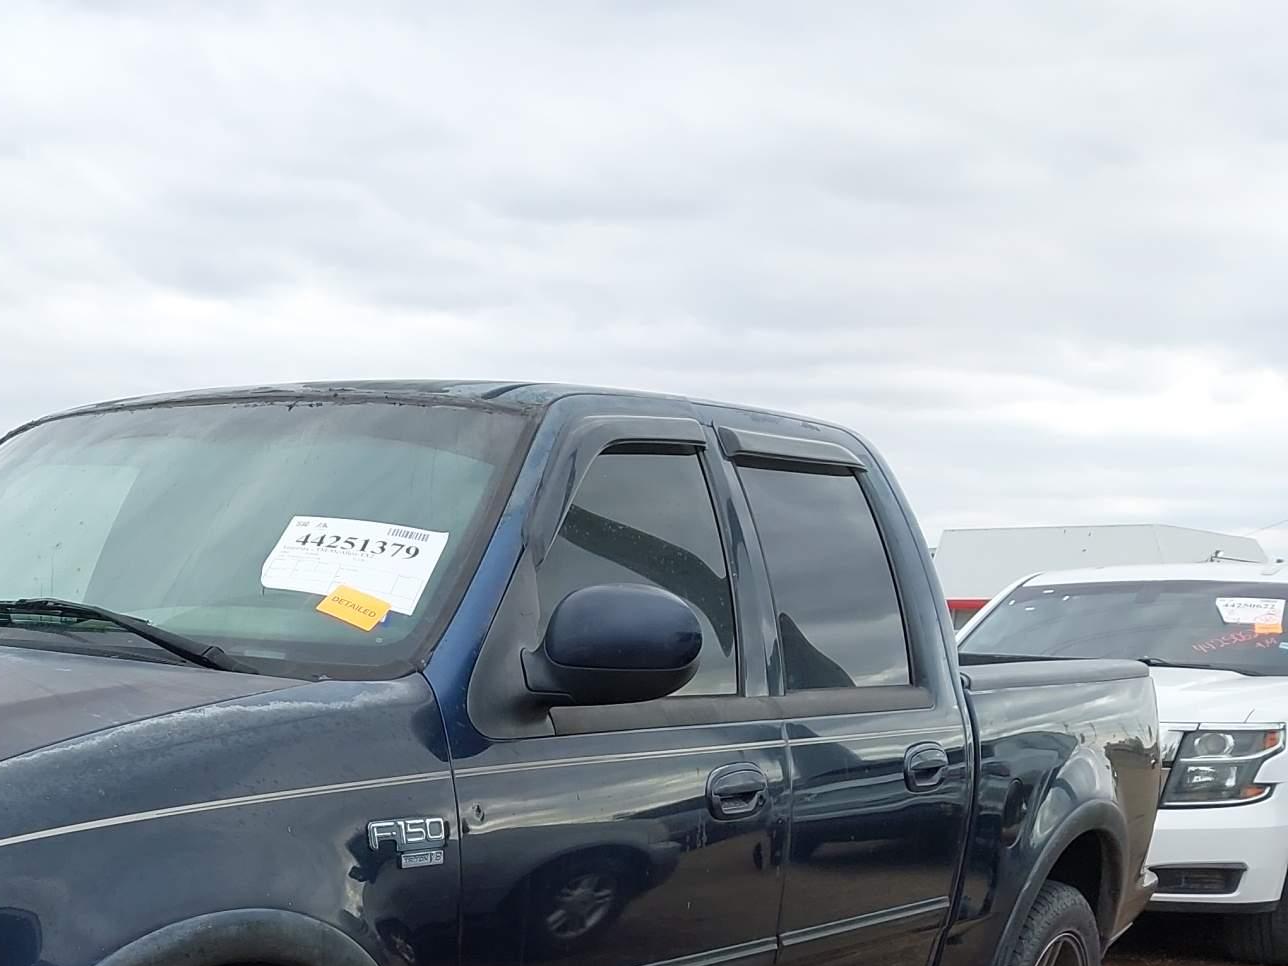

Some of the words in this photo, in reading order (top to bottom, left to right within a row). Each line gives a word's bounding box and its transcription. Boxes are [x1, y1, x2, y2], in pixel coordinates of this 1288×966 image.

[295, 532, 420, 560] 44251379
[330, 595, 377, 618] DETAILED
[368, 817, 445, 849] F-150
